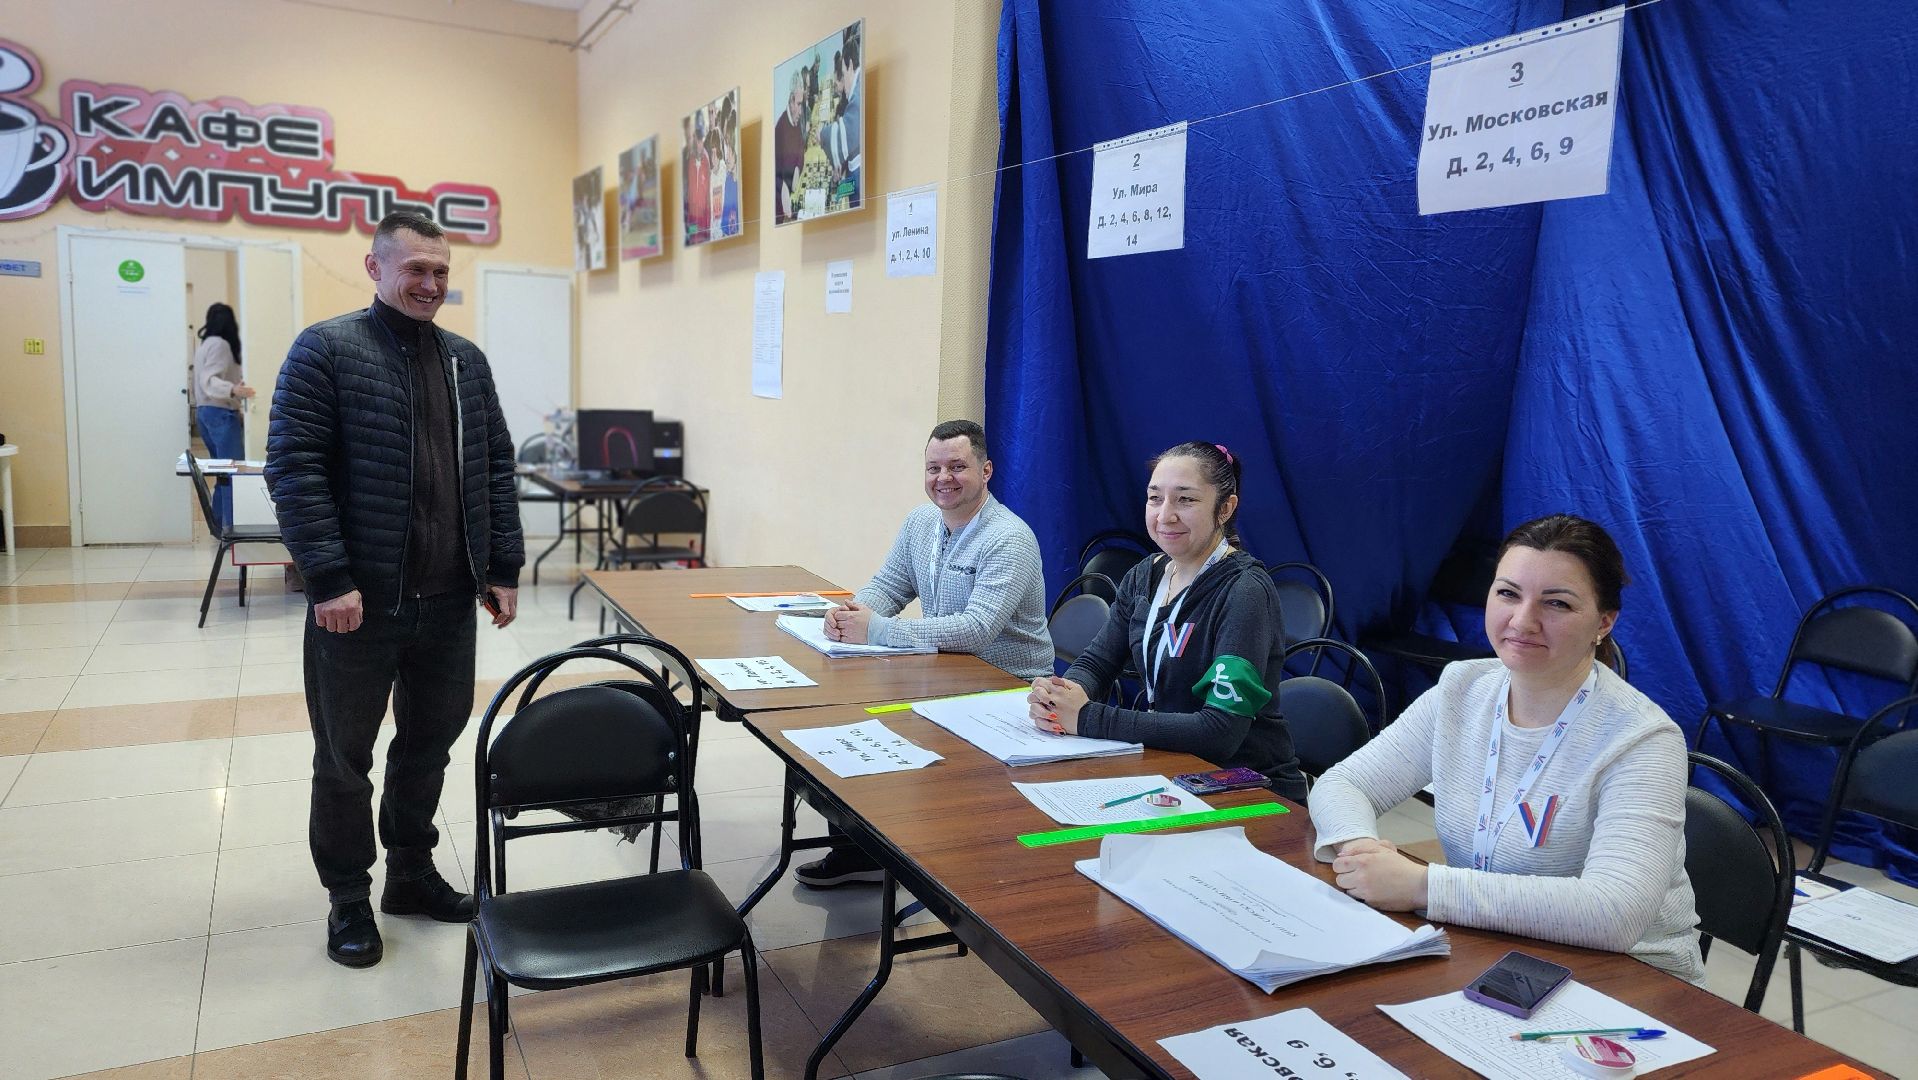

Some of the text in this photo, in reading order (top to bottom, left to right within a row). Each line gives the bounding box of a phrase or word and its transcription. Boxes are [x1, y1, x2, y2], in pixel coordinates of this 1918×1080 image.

[1510, 62, 1524, 83] 3
[73, 92, 322, 160] КАФЕ
[1427, 91, 1608, 141] Ул. Московская
[1133, 153, 1140, 168] 2
[1446, 136, 1574, 179] Д. 2, 4, 6, 9
[1112, 183, 1158, 199] Ул. Мира
[1097, 206, 1172, 229] Д. 2, 4, 6, 8, 12,
[903, 225, 929, 238] Ленина
[1126, 234, 1138, 246] 14
[922, 247, 931, 259] 10
[1287, 1039, 1336, 1069] 6, 9
